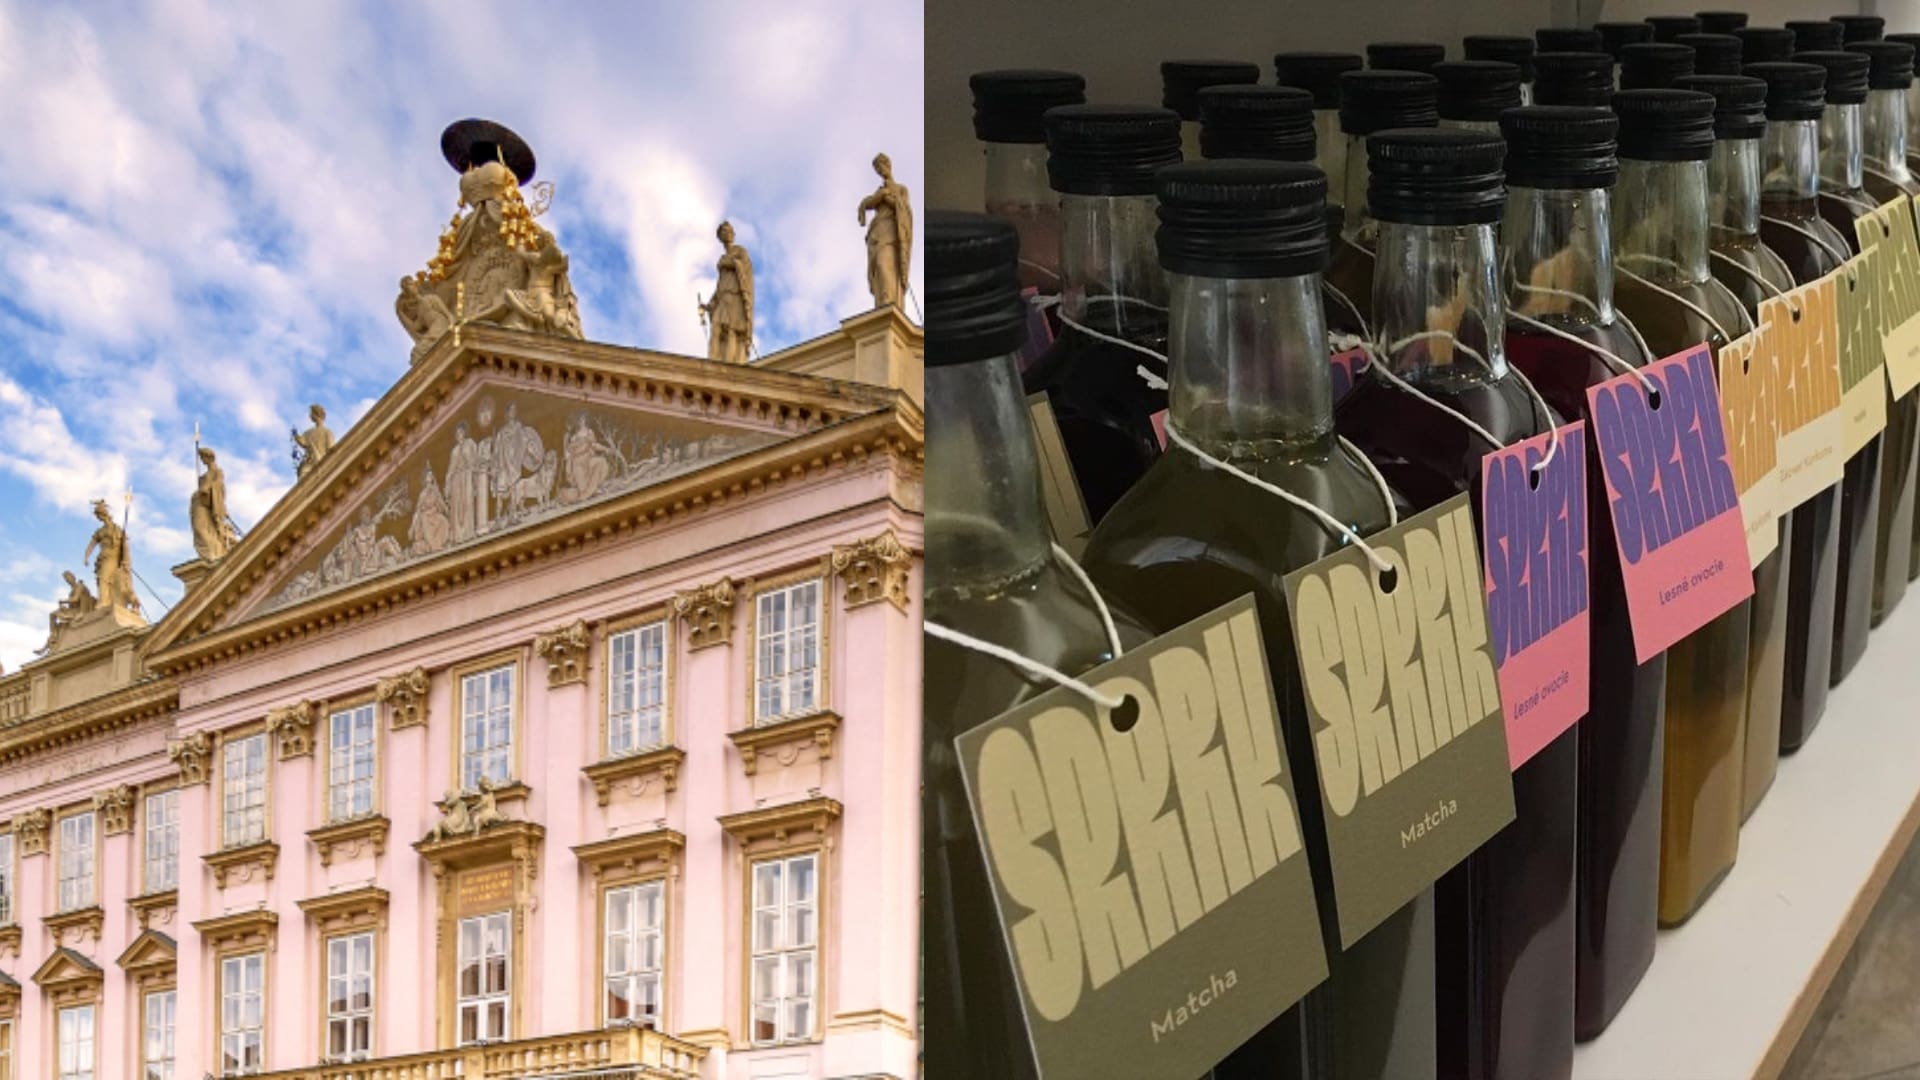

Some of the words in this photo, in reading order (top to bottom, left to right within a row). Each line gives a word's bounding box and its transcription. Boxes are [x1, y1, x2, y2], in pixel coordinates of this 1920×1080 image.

[1659, 575, 1689, 605] Lesné
[1690, 558, 1724, 586] ovocie
[1514, 686, 1540, 720] Lesné
[1541, 669, 1569, 699] ovocie
[1400, 798, 1459, 849] Matcha
[1151, 966, 1239, 1043] Matcha
